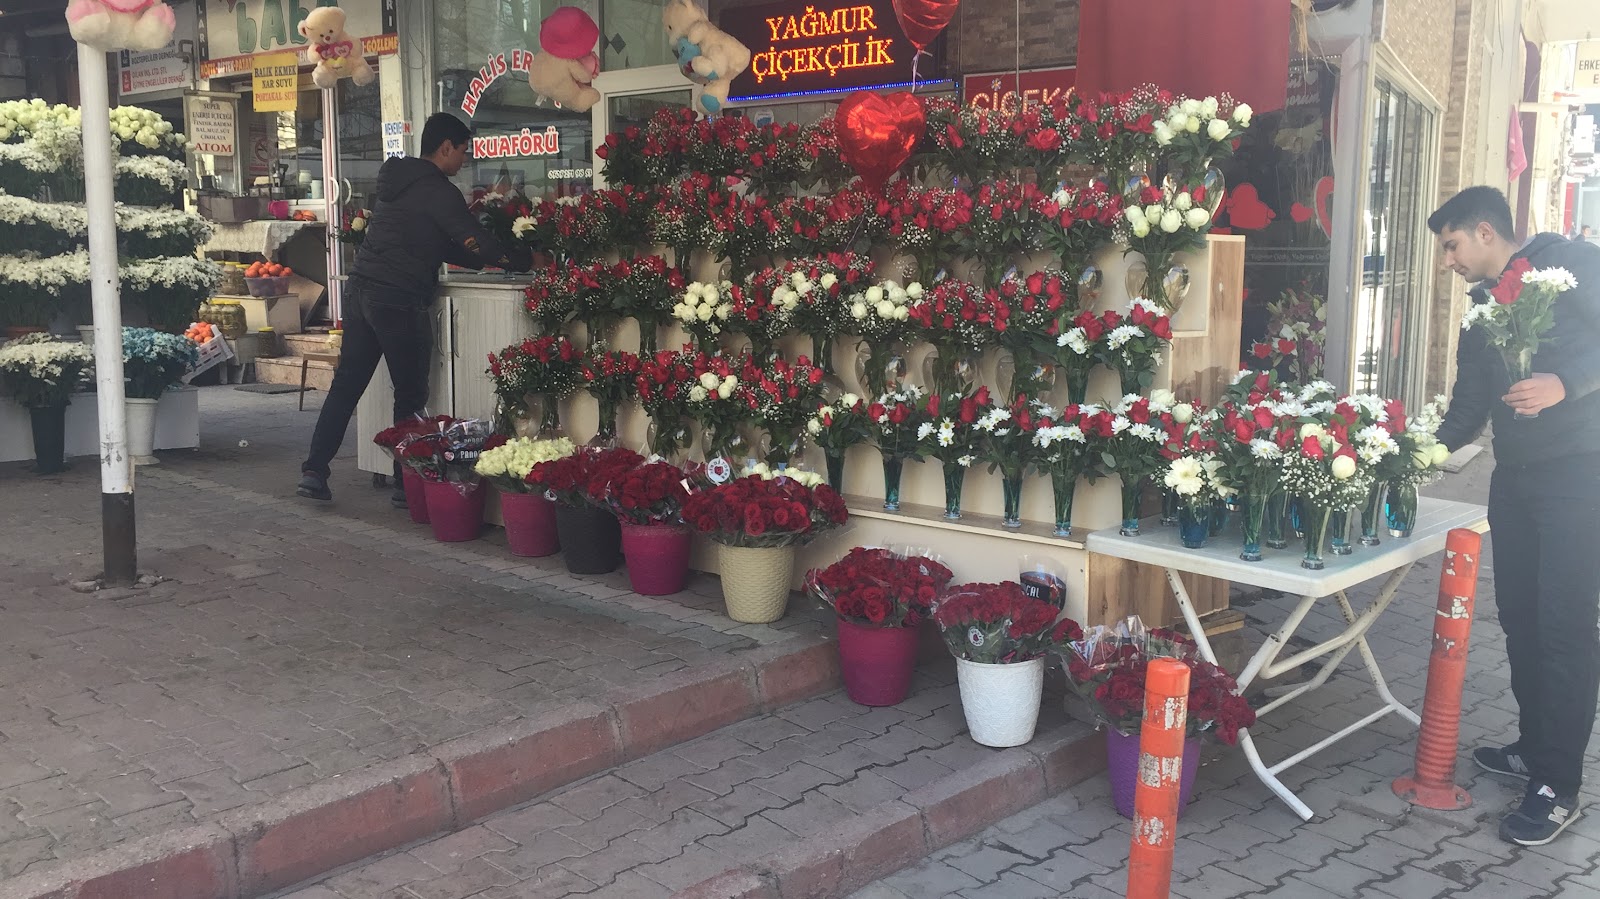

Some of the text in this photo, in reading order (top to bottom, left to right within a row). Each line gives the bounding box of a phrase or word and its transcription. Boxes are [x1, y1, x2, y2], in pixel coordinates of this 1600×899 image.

[765, 6, 877, 41] YAĞMUR
[254, 65, 297, 77] BALIK EKMEK
[752, 35, 895, 83] ÇİÇEKÇİLİK
[276, 78, 293, 88] SUYU
[461, 52, 506, 117] HALİS
[195, 143, 232, 152] ATOM
[473, 125, 560, 160] KUAFÖRÜ
